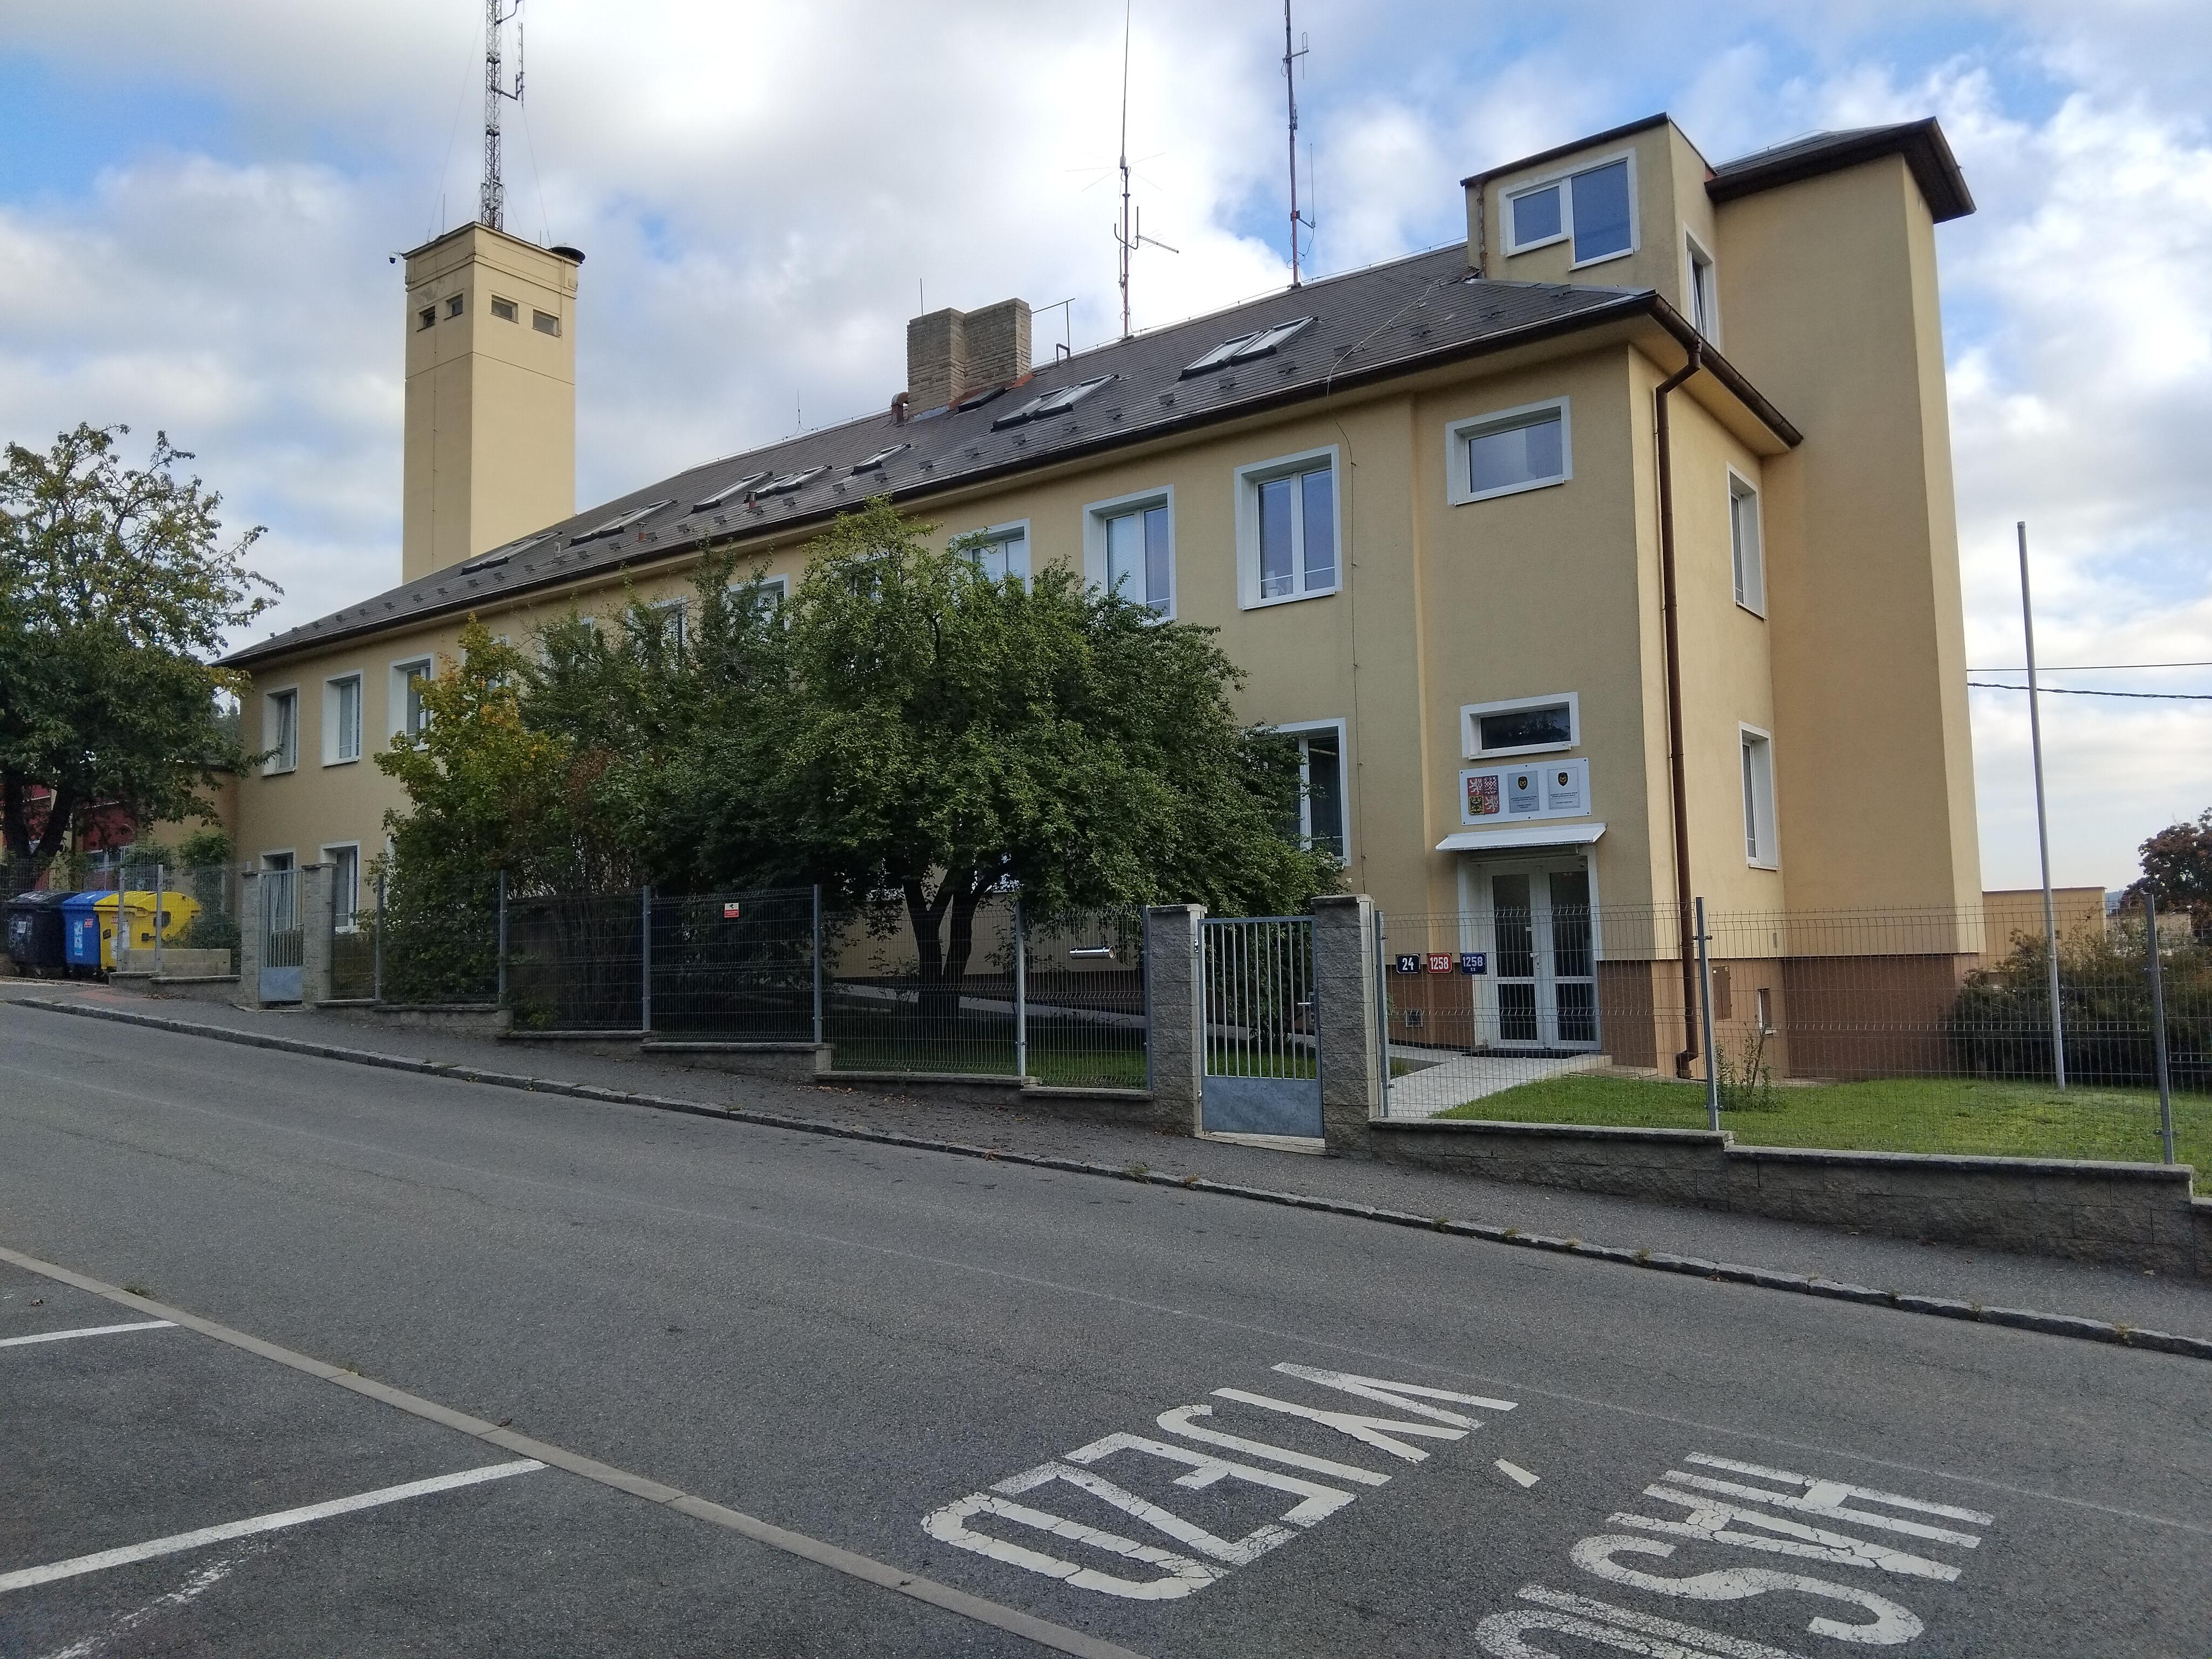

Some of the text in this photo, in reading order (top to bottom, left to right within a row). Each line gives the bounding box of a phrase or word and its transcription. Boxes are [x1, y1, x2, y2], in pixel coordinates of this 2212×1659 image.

[1402, 957, 1414, 971] 24
[1430, 957, 1448, 970] 1258
[1462, 956, 1483, 967] 1258
